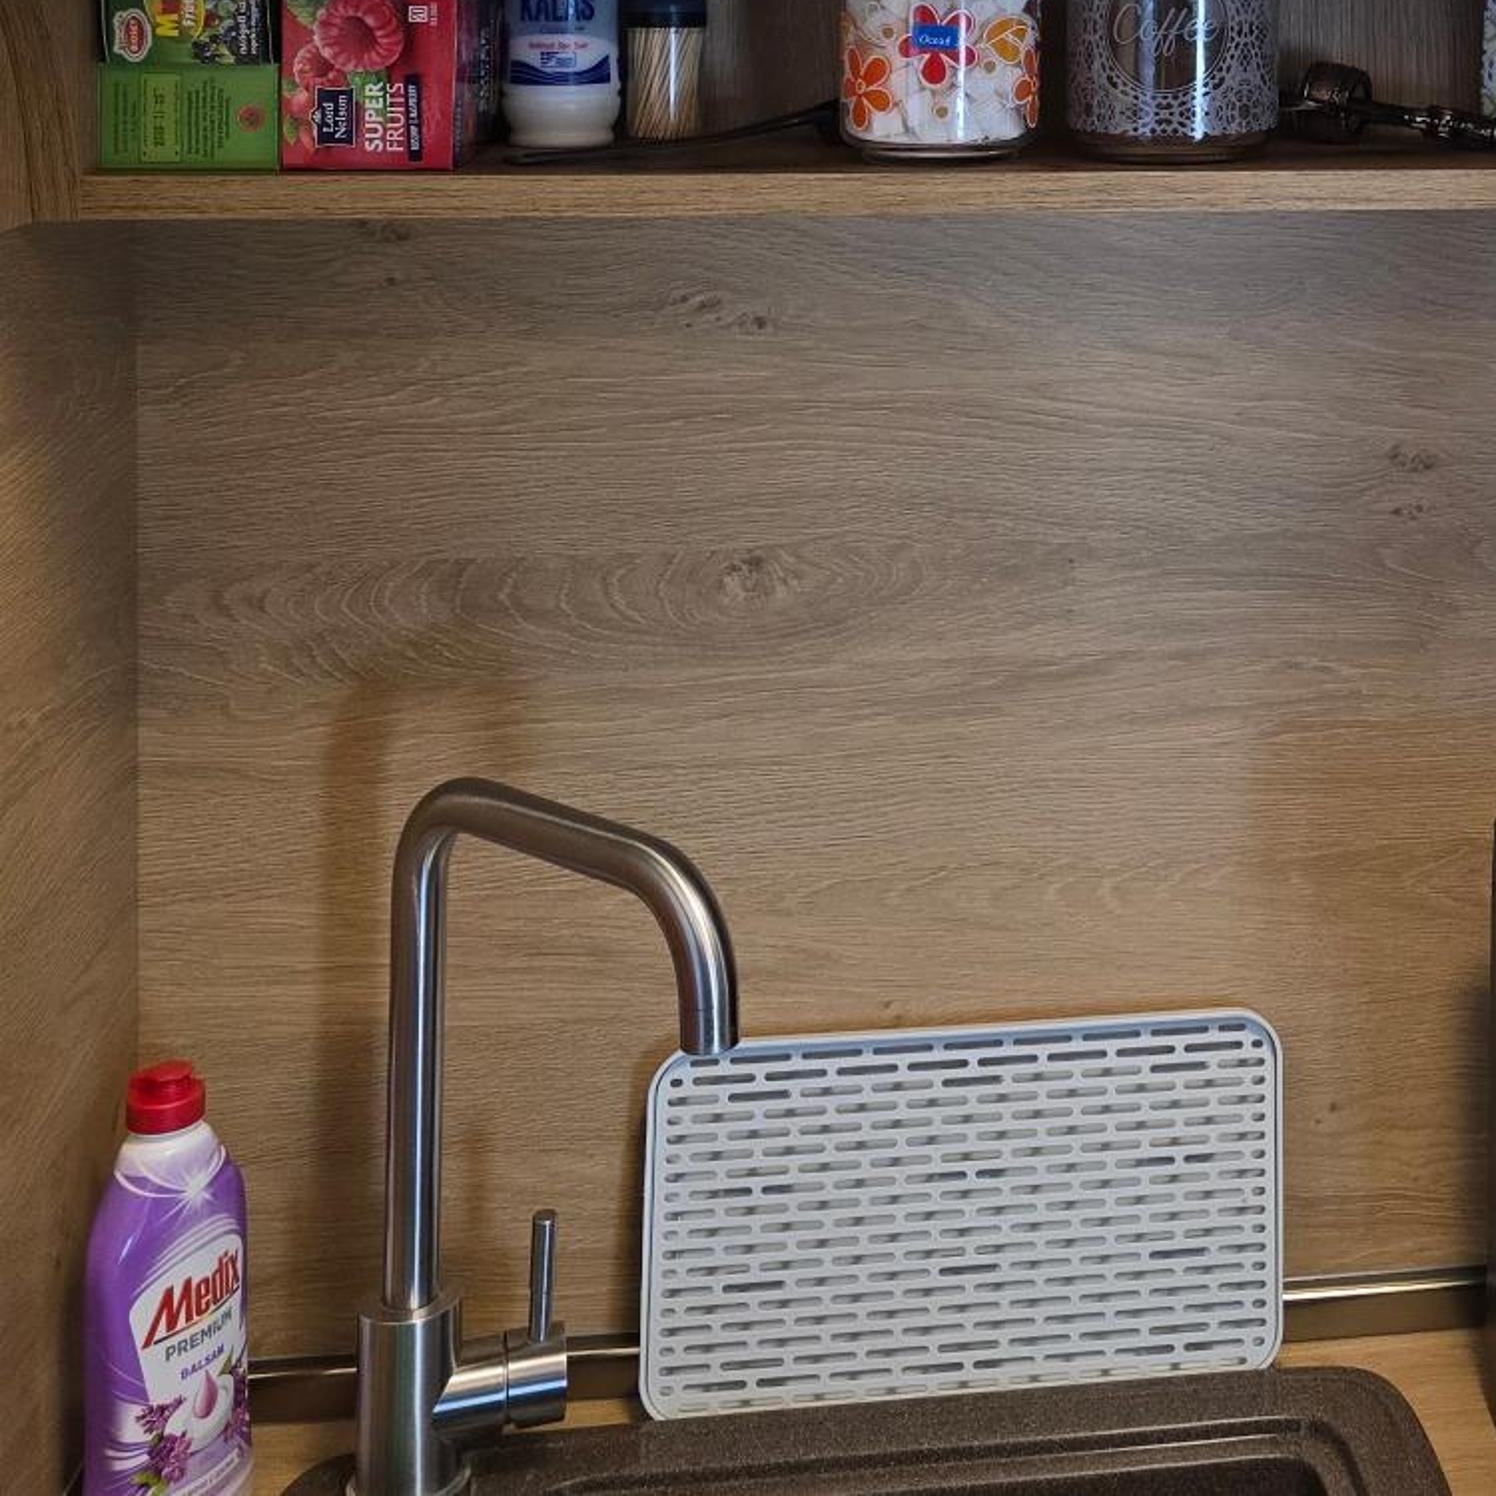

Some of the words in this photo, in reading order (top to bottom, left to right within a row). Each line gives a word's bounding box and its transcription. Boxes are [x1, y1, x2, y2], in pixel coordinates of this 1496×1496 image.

[1113, 2, 1216, 57] Coffee
[322, 102, 334, 133] Lord
[335, 95, 348, 139] Nelson
[364, 81, 384, 152] SUPER
[386, 82, 405, 152] FRUITS
[141, 1248, 240, 1352] Medix
[165, 1305, 233, 1361] PREMIUM
[181, 1343, 225, 1381] BALSAM
